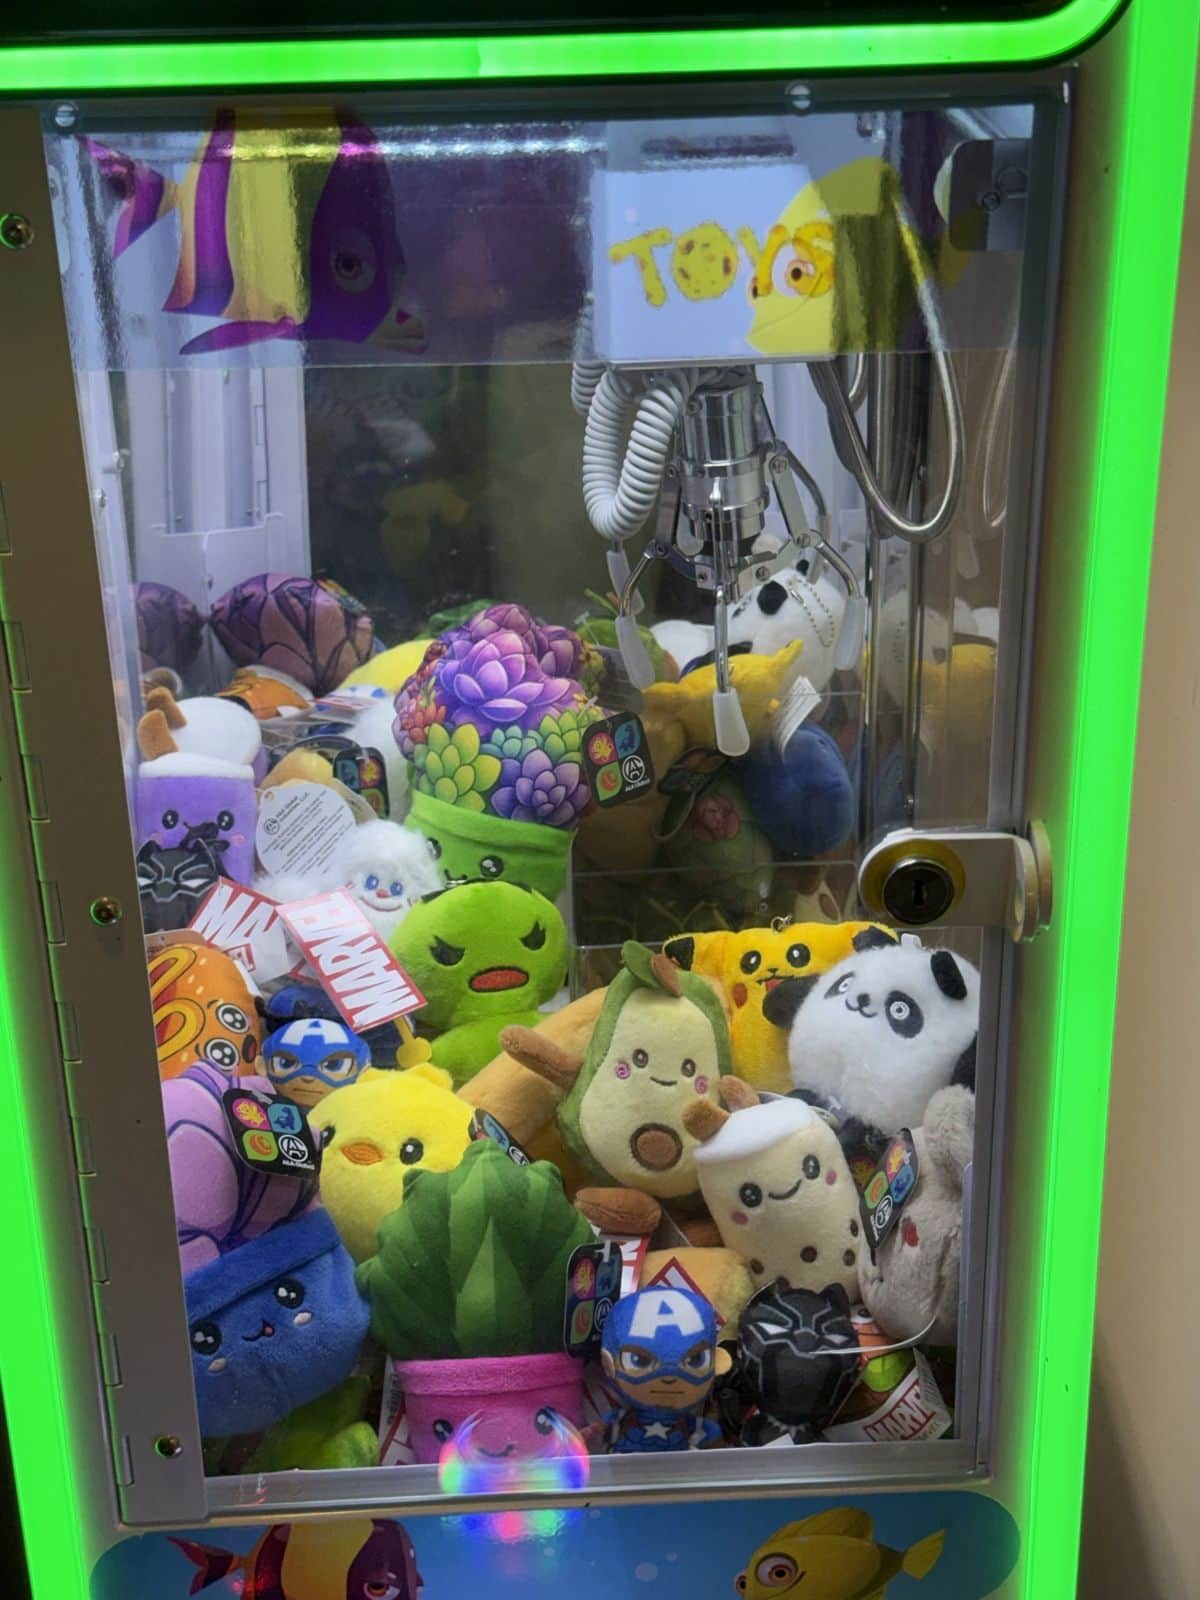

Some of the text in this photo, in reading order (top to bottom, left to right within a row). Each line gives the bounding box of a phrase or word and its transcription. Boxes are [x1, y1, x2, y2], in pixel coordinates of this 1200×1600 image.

[608, 221, 836, 308] TOYS
[281, 891, 419, 1028] MARVEL
[280, 1018, 350, 1046] A
[628, 1290, 705, 1340] A
